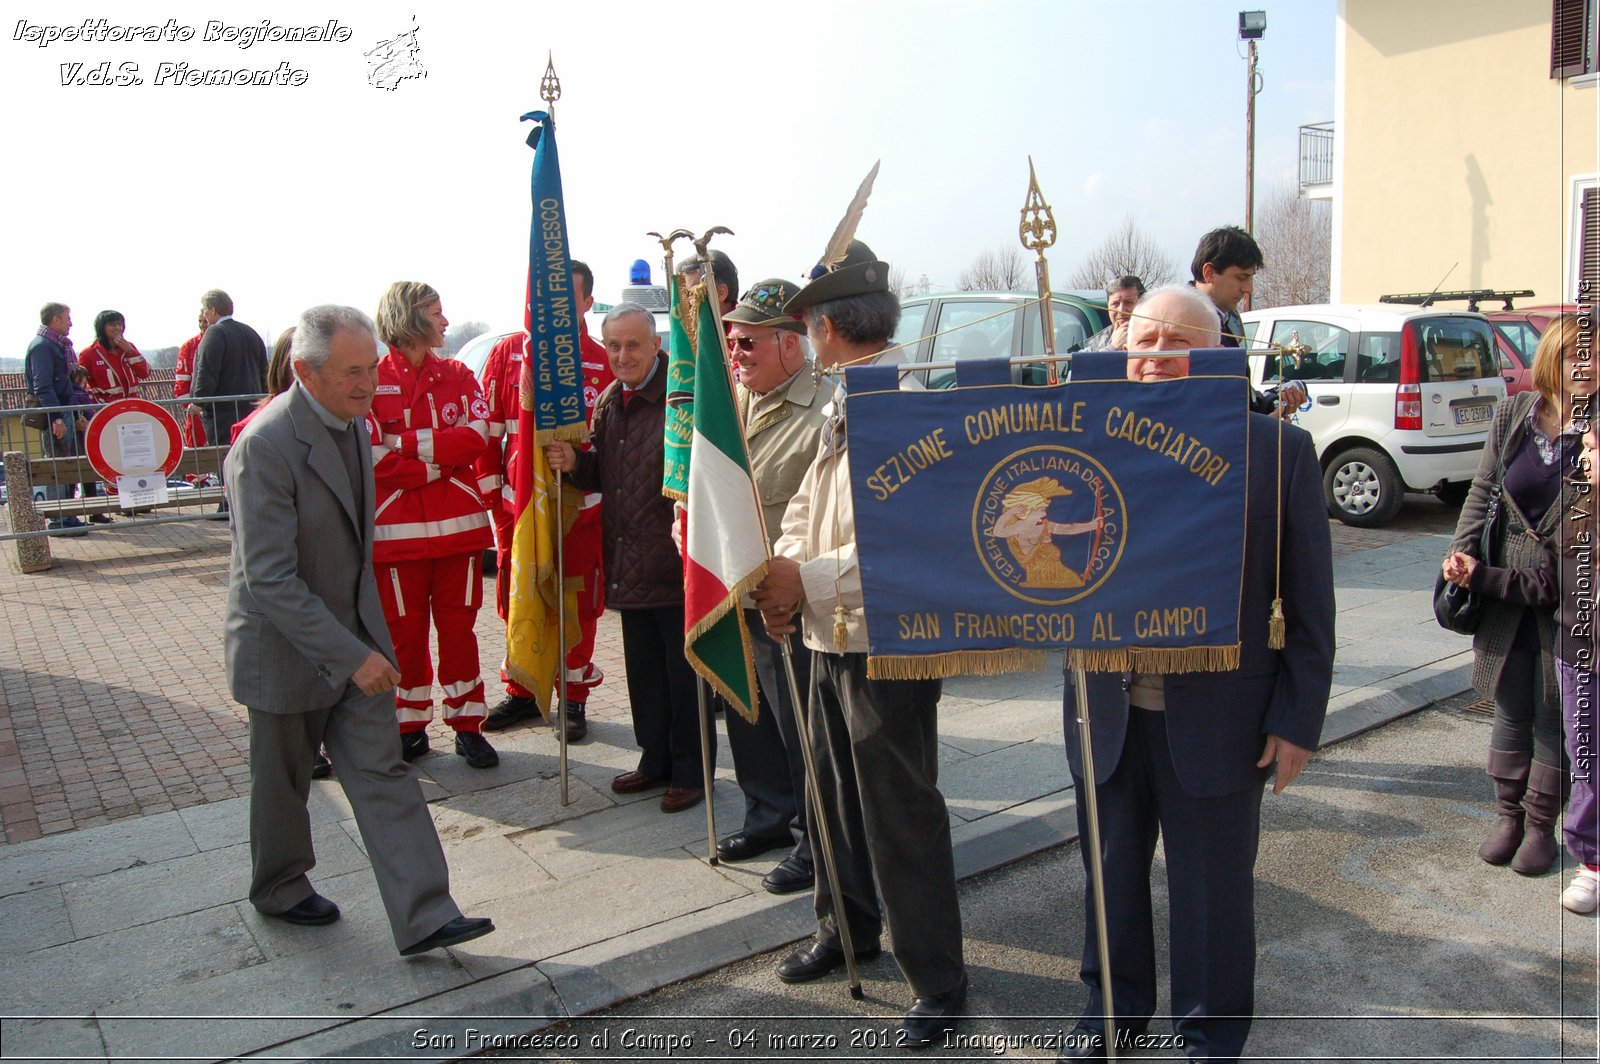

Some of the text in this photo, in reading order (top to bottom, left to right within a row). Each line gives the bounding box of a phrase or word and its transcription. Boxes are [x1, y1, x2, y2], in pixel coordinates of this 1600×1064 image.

[539, 198, 568, 291] FRANCESCO
[551, 297, 572, 328] SAN
[554, 333, 577, 387] ARDOR
[560, 392, 580, 420] U.S.
[866, 401, 1231, 502] SEZIONE COMUNALE CACCIATORI
[982, 476, 1023, 584] FEDERAZIONE
[1006, 456, 1080, 481] ITALIANA
[899, 606, 1207, 643] SAN FRANCESCO AL CAMPO
